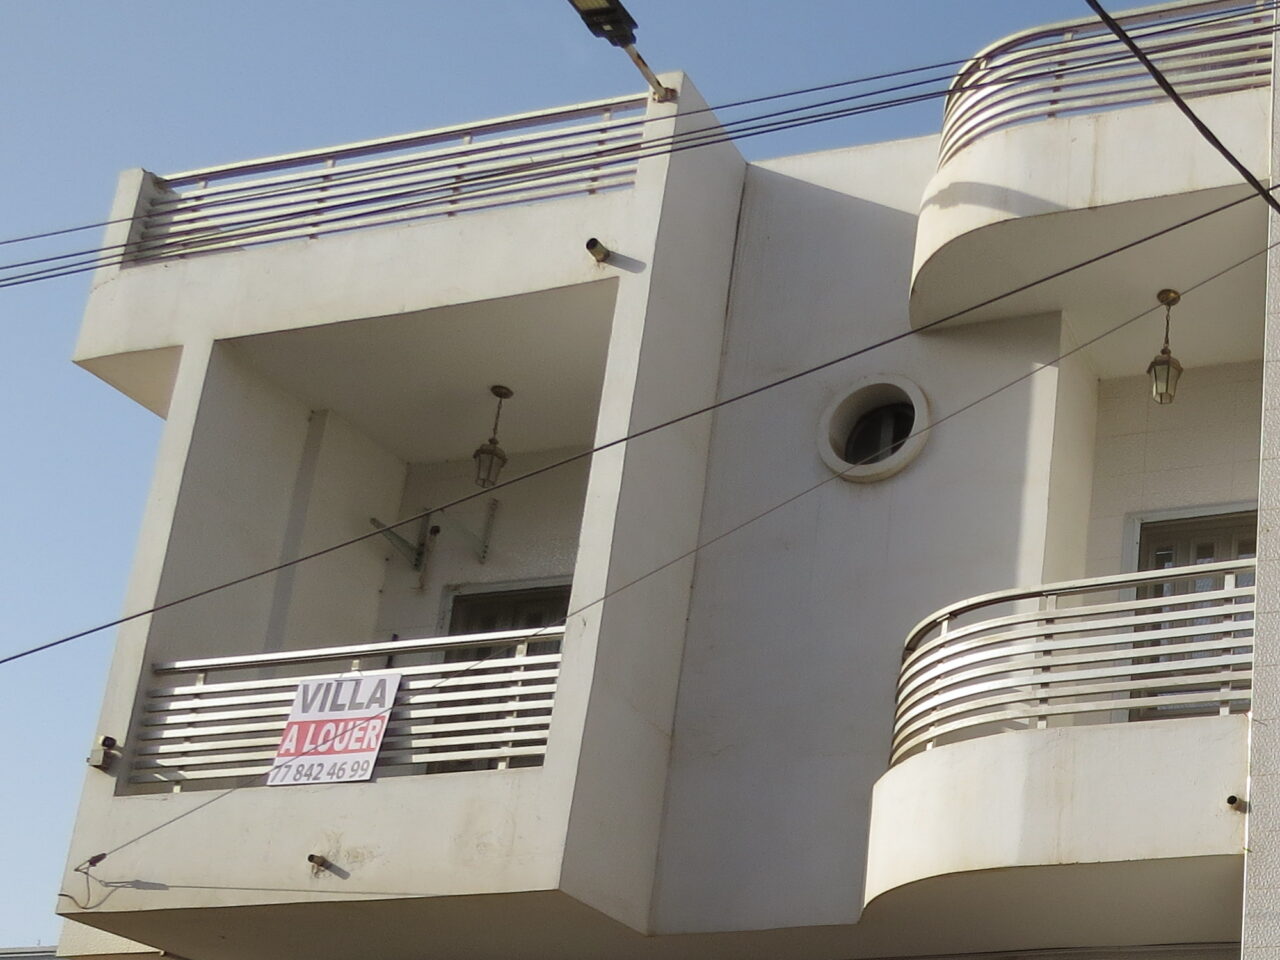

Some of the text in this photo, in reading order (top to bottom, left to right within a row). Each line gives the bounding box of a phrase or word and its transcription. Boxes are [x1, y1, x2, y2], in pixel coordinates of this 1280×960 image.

[302, 679, 387, 713] VILLA
[280, 719, 382, 754] A LOUER
[270, 760, 370, 783] 77 842 46 99
